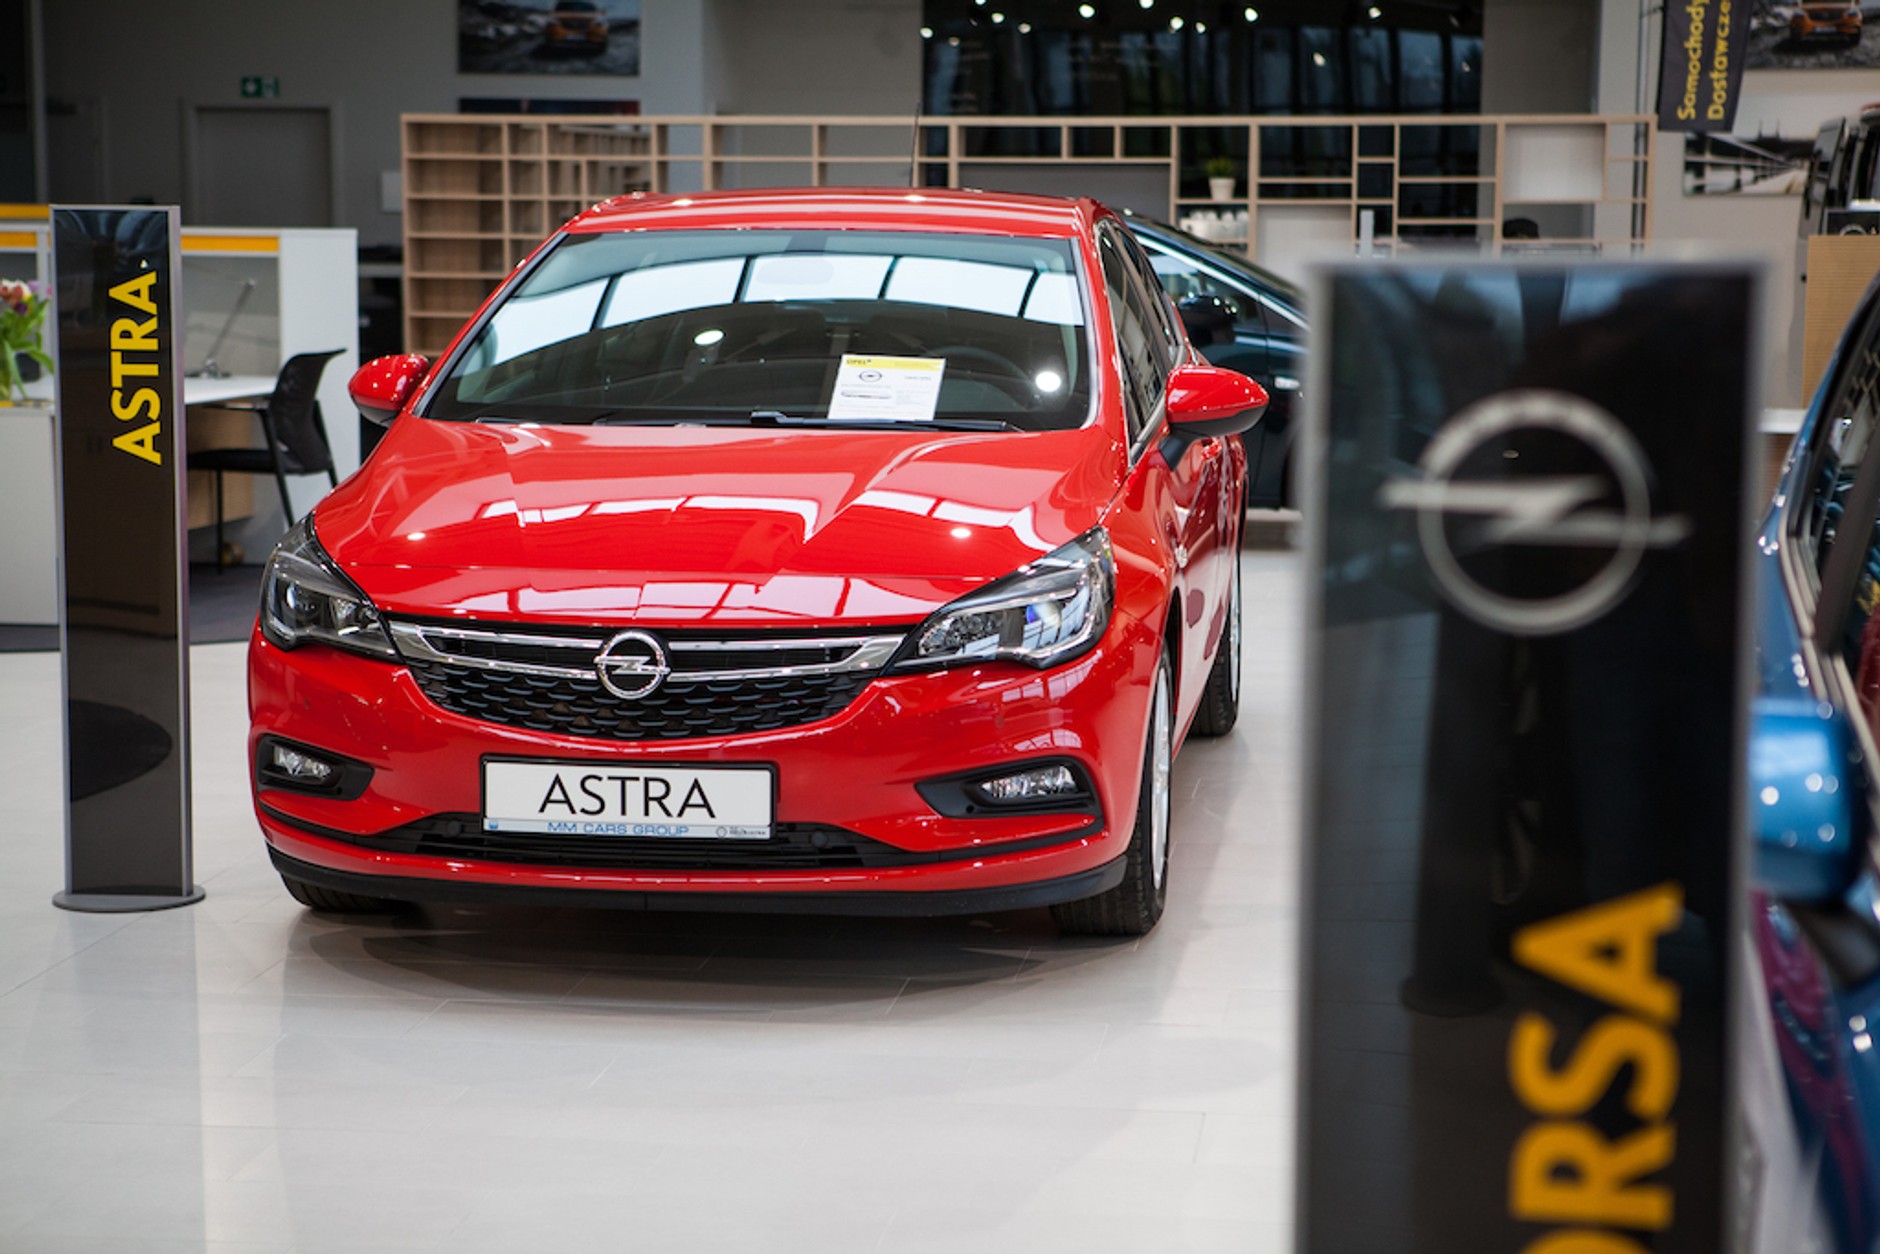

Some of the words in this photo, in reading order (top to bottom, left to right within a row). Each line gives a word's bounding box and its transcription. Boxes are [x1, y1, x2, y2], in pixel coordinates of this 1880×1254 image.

[1707, 0, 1731, 120] Dostawcze
[109, 271, 162, 465] ASTRA
[538, 773, 716, 818] ASTRA
[547, 822, 578, 832] MM
[583, 823, 627, 834] CARS
[633, 824, 690, 836] GROUP
[1510, 884, 1683, 1254] RSA
